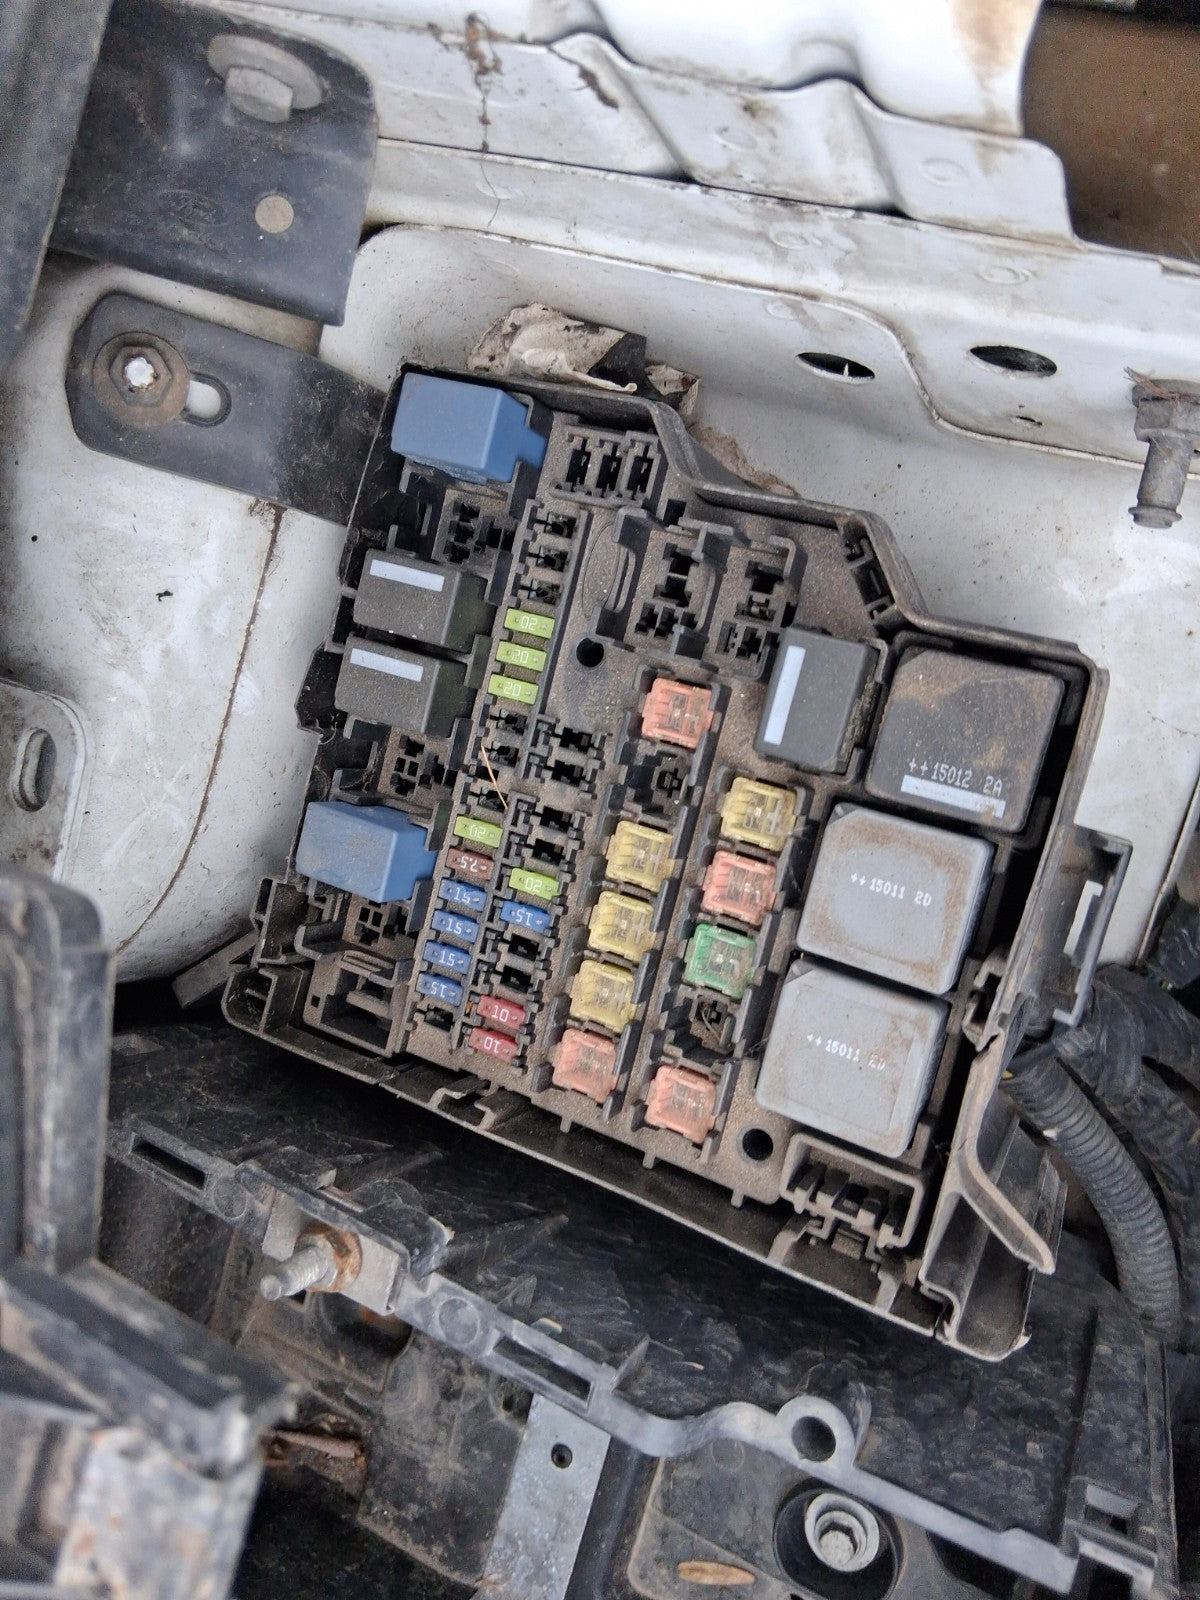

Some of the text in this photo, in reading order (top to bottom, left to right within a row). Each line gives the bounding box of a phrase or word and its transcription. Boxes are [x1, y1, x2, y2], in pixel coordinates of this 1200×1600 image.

[512, 649, 529, 664] 20
[503, 682, 521, 697] 20
[983, 775, 1003, 797] 2A
[460, 855, 478, 872] 7.5
[453, 887, 471, 903] 15
[515, 907, 533, 924] 15
[445, 918, 462, 935] 15
[439, 950, 455, 965] 15
[430, 981, 448, 997] 15
[492, 1006, 510, 1022] 10
[483, 1037, 500, 1052] 10
